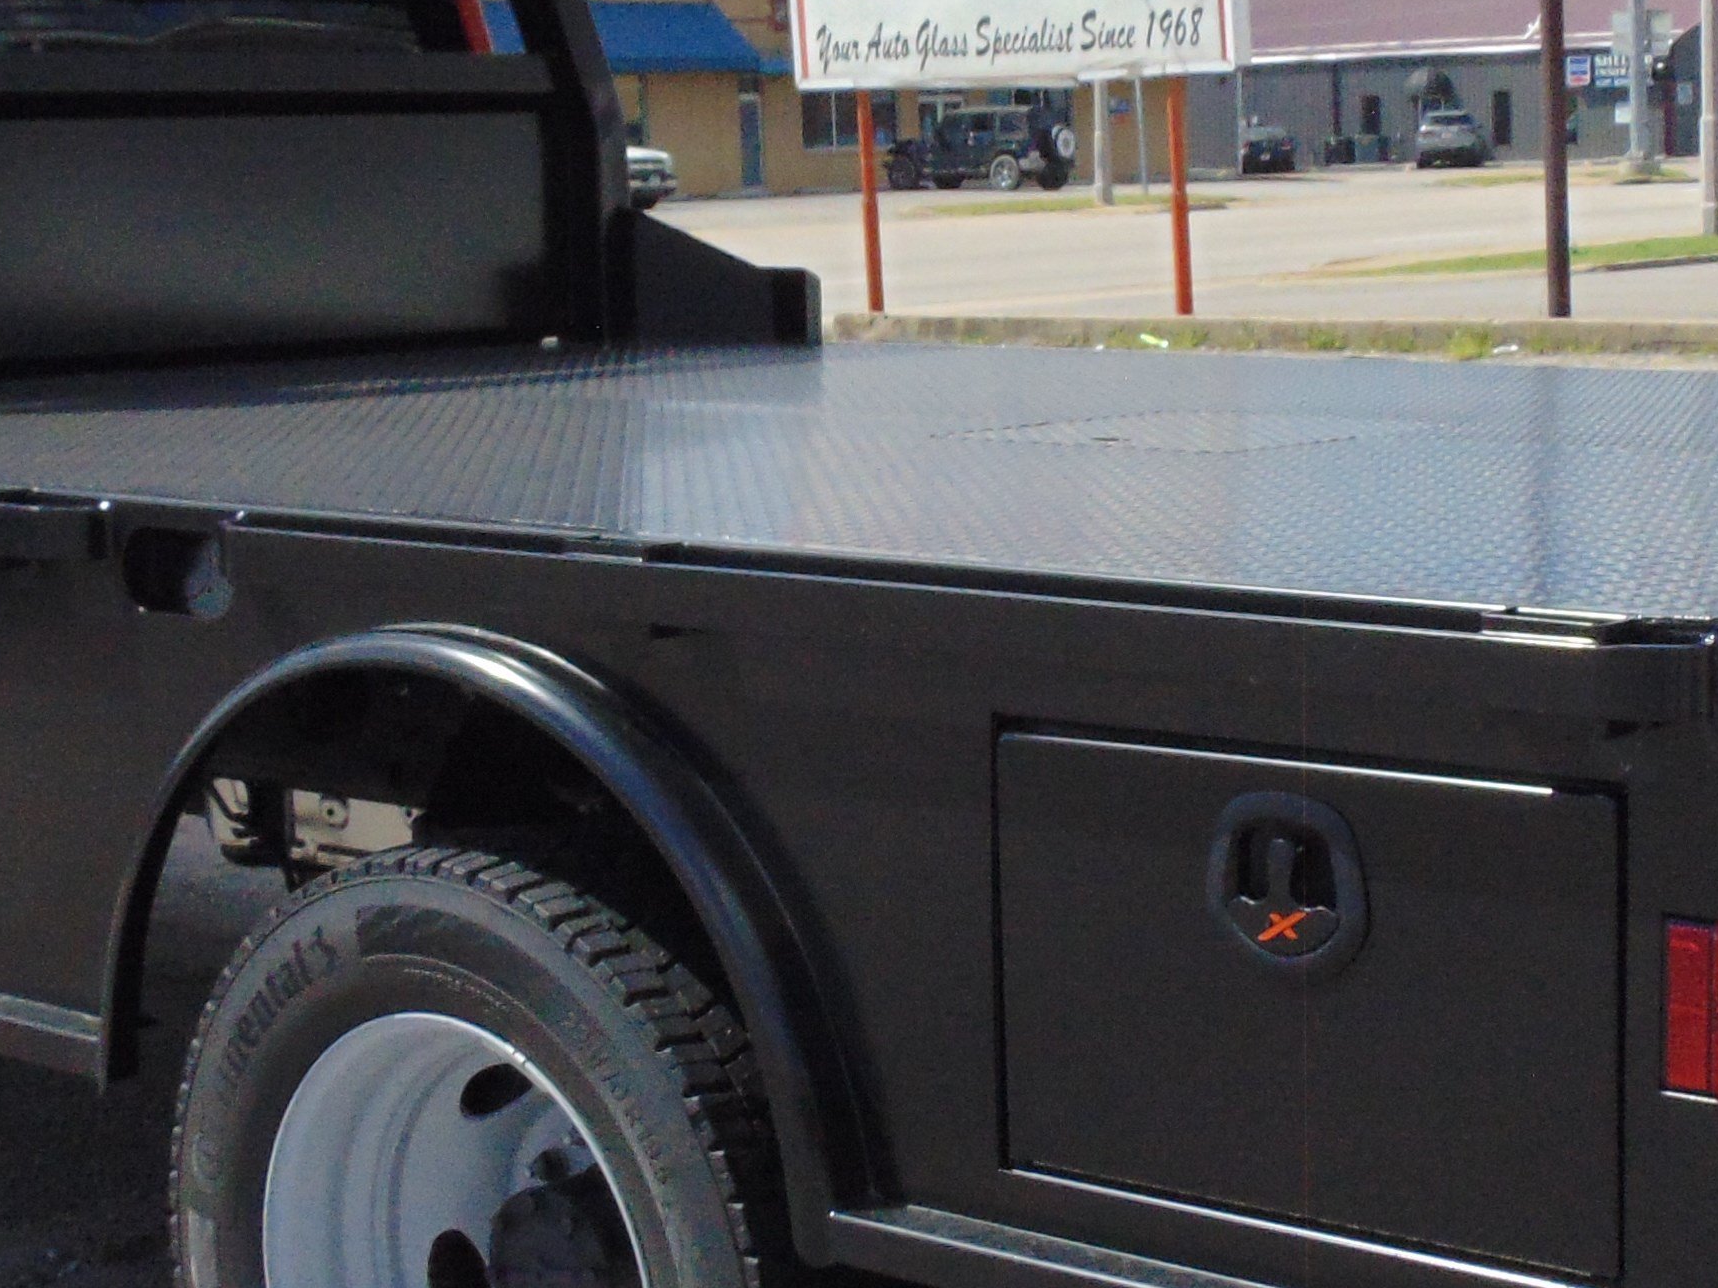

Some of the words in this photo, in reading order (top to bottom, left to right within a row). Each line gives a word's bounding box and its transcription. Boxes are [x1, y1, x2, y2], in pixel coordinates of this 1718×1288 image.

[816, 24, 860, 74] Your
[866, 22, 911, 62] Auto
[916, 19, 969, 71] Glass
[975, 16, 1074, 66] Specialist
[1081, 10, 1136, 51] Since
[1145, 7, 1204, 49] 1968
